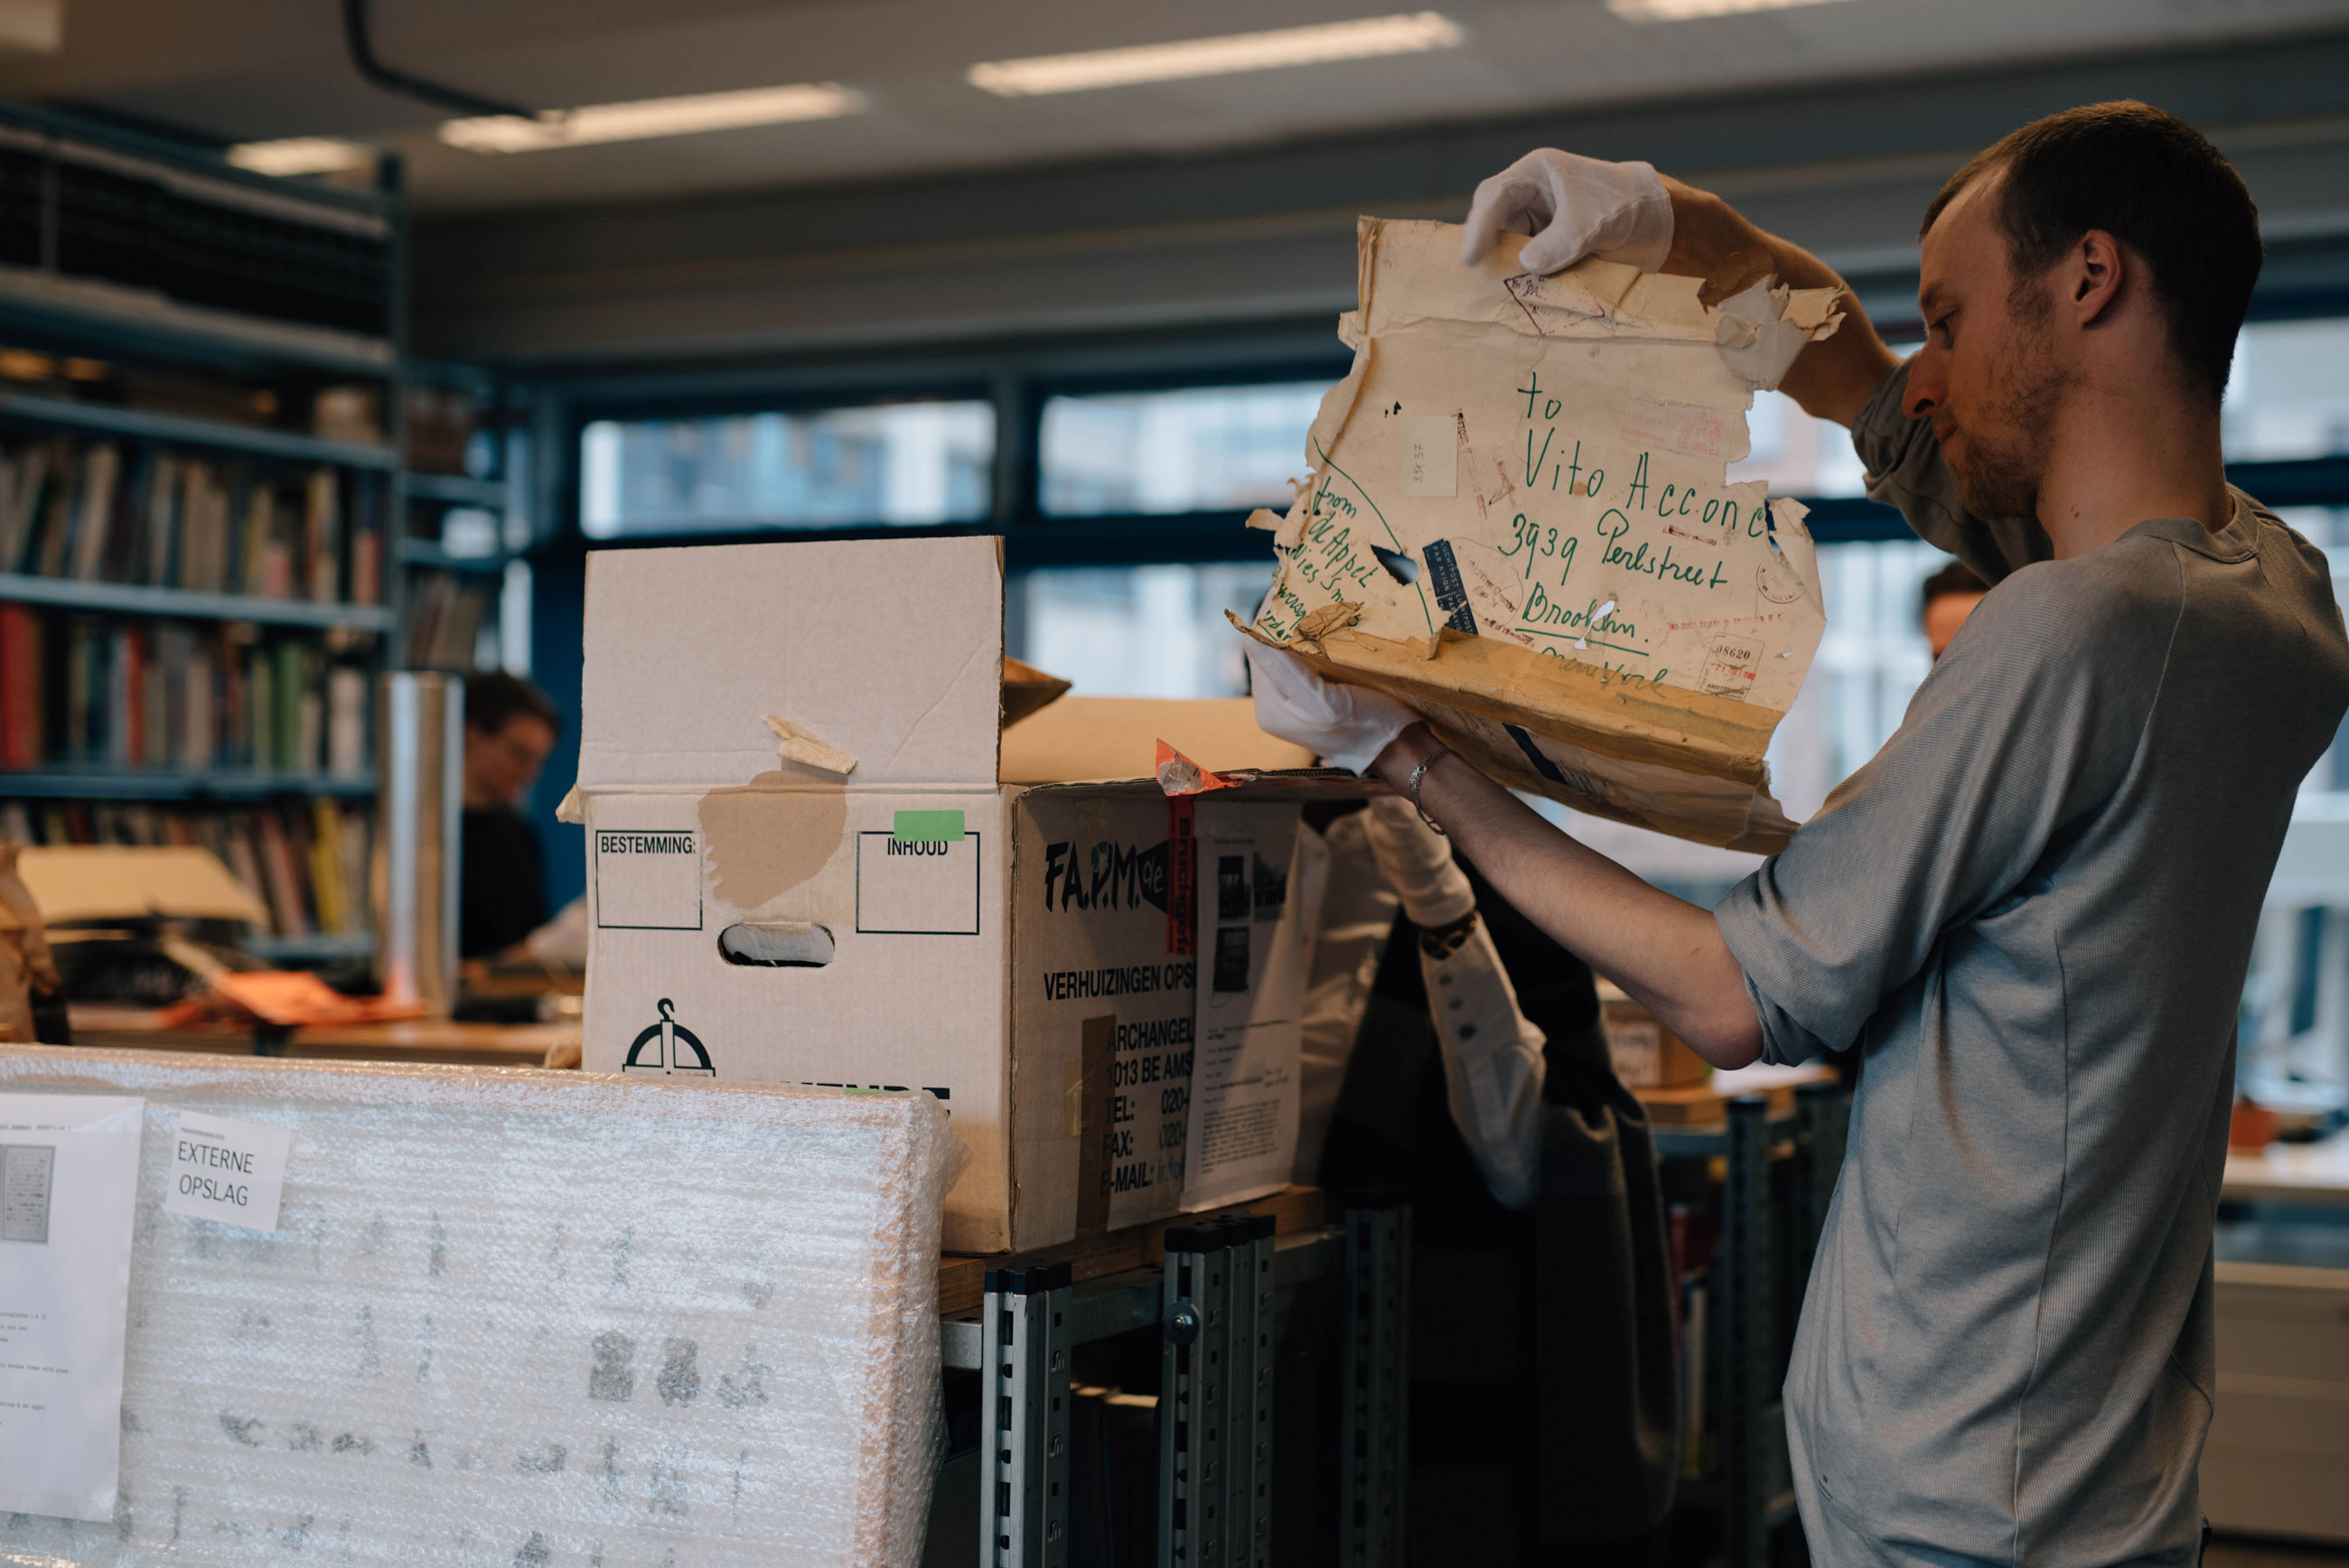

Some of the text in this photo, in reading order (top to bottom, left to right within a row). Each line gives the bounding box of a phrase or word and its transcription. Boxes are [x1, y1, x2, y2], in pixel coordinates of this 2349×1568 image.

[1517, 371, 1562, 420] to
[1524, 426, 1605, 498] Vito
[1313, 476, 1358, 520] from
[1497, 512, 1579, 586] 3939
[1455, 593, 1474, 634] LUHTPOST
[1717, 644, 1751, 660] 08620
[601, 835, 697, 855] BESTEMMING:
[887, 837, 949, 856] INHOUD
[1043, 965, 1161, 1002] VERHUIZINGEN
[1108, 1059, 1138, 1089] 1013
[1142, 1056, 1161, 1084] BE
[1105, 1095, 1135, 1125] TEL:
[178, 1140, 255, 1175] EXTERNE
[1101, 1130, 1134, 1161] FAX:
[179, 1173, 248, 1207] OPSLAG
